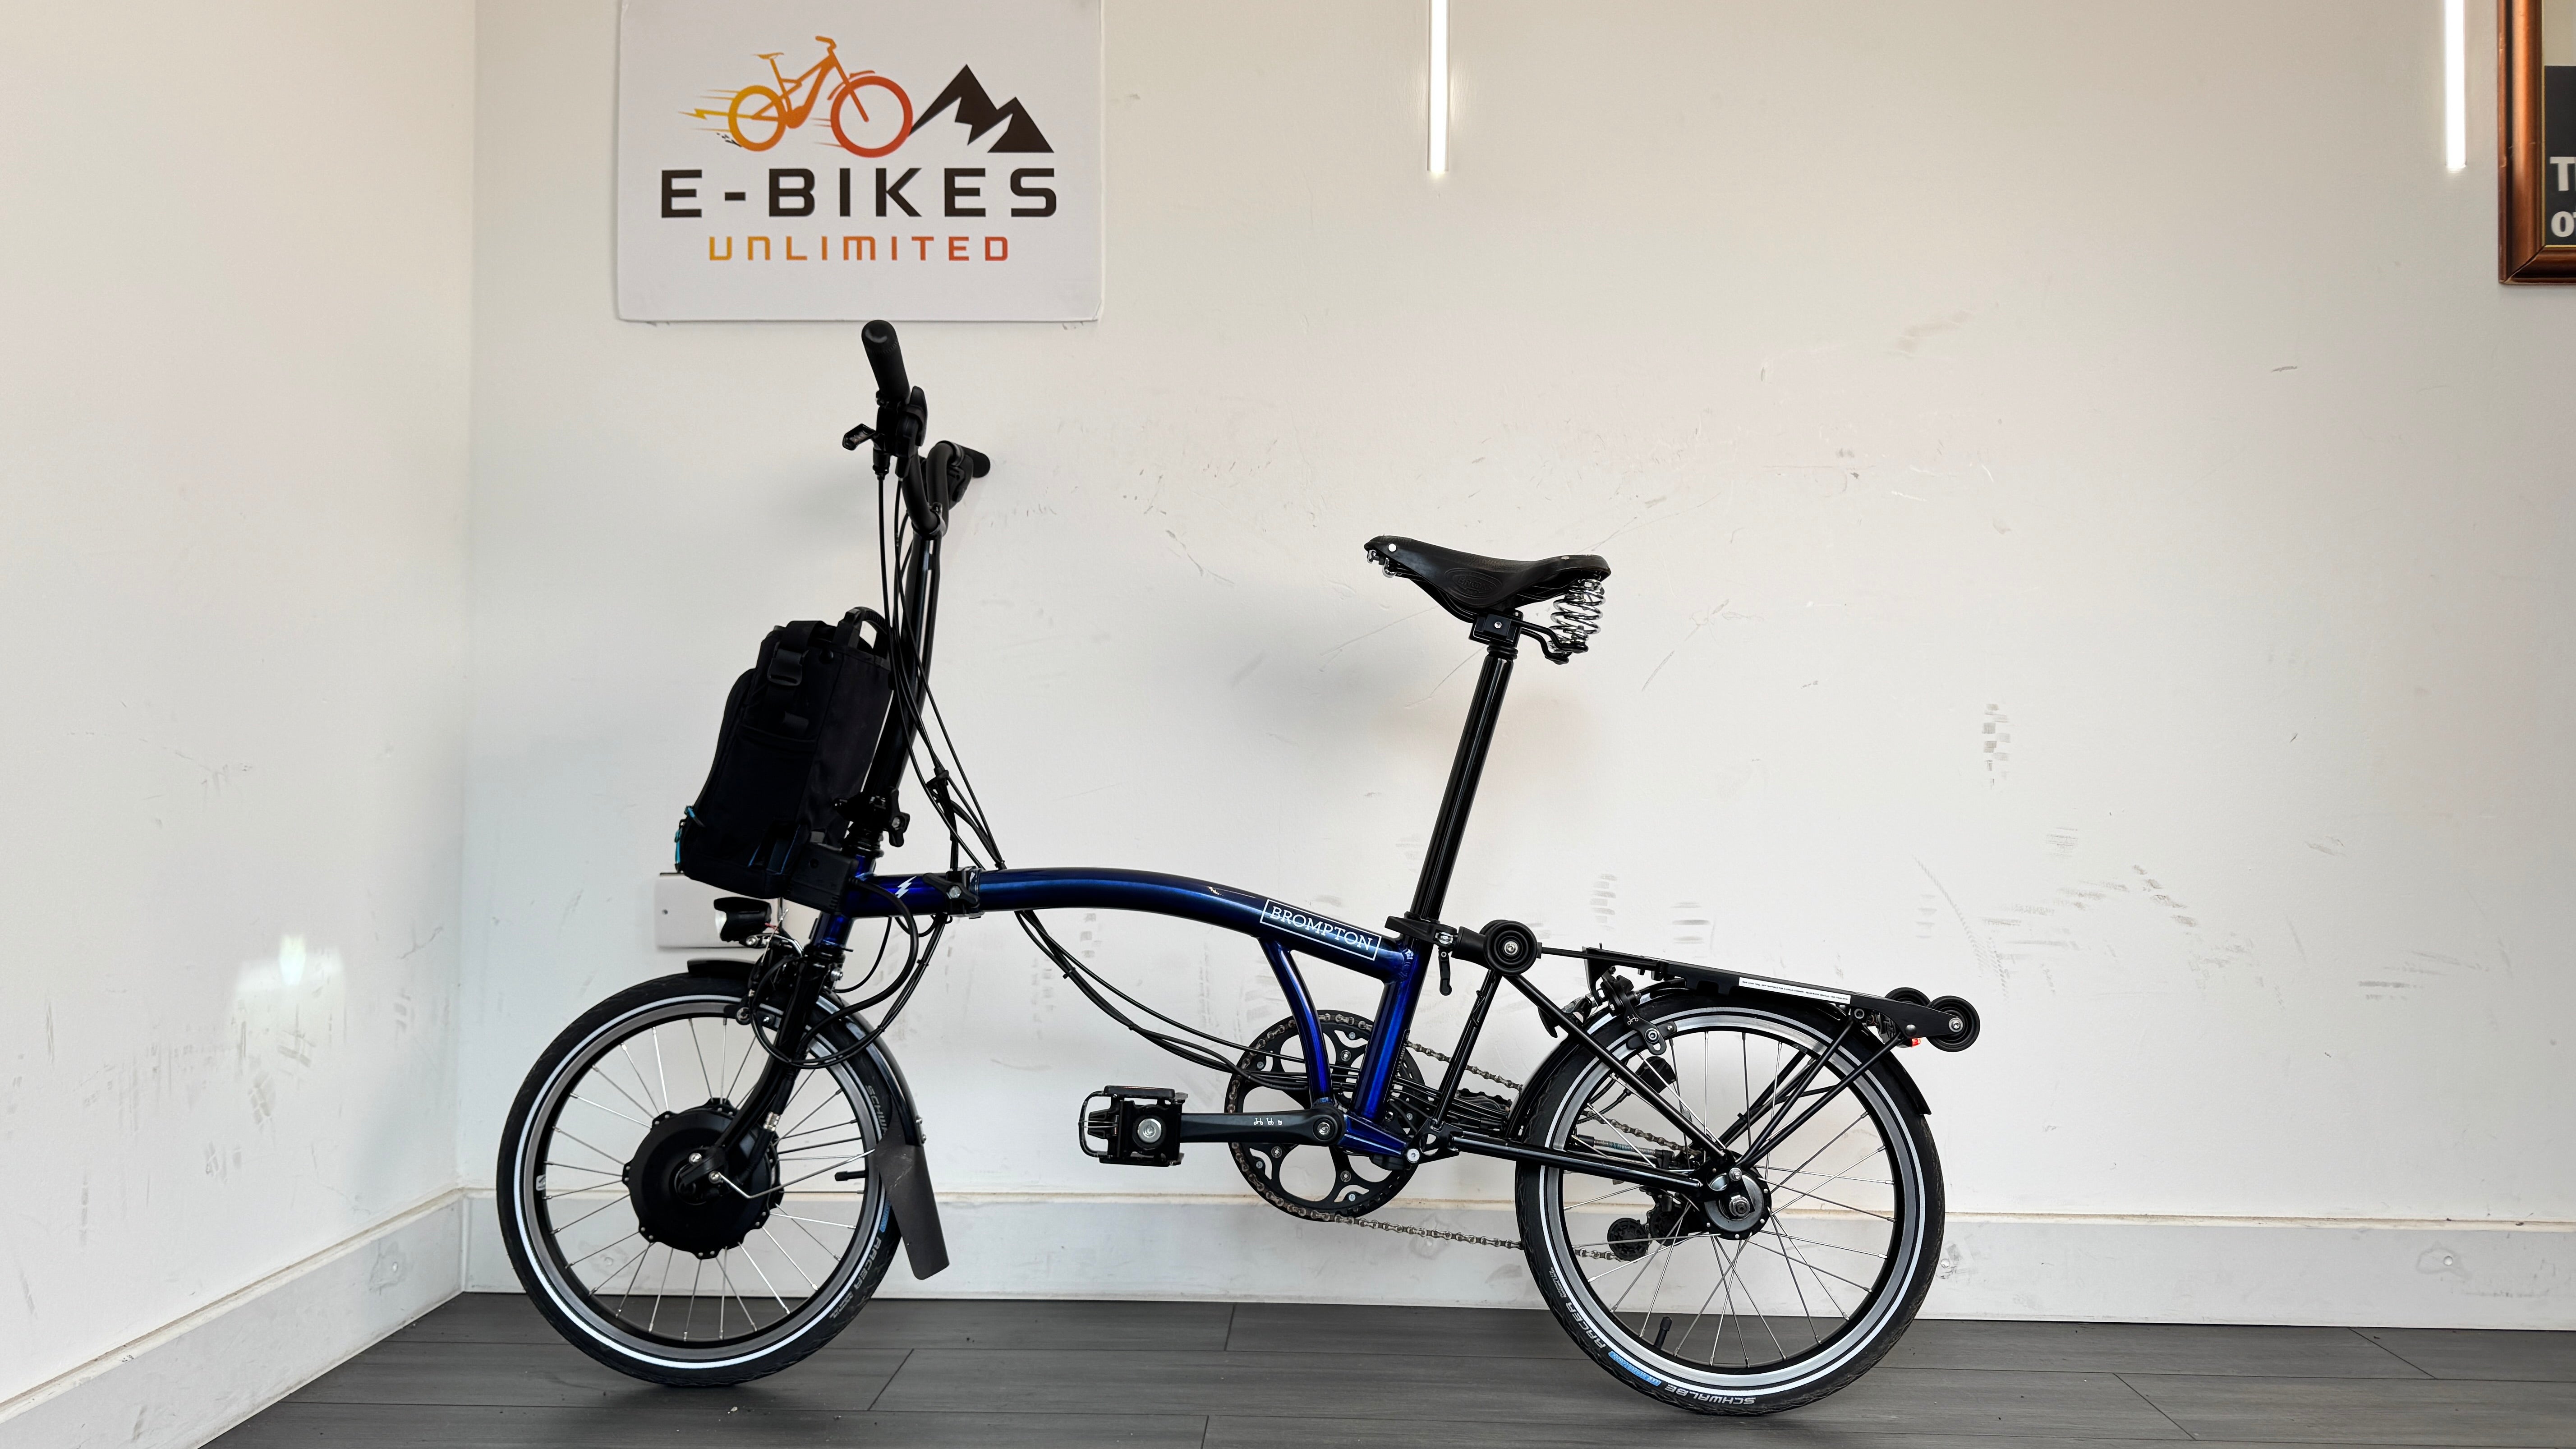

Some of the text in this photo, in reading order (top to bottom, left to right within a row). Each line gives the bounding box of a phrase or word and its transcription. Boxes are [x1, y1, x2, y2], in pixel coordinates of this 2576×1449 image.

[661, 168, 1057, 218] E-BIKES
[2550, 156, 2576, 191] T
[709, 236, 1008, 261] UNLIMITED
[1270, 906, 1373, 951] BROMPTON
[854, 1237, 882, 1291] RACER
[1566, 1302, 1606, 1348] RACER
[1665, 1384, 1756, 1404] SCHWALBE
